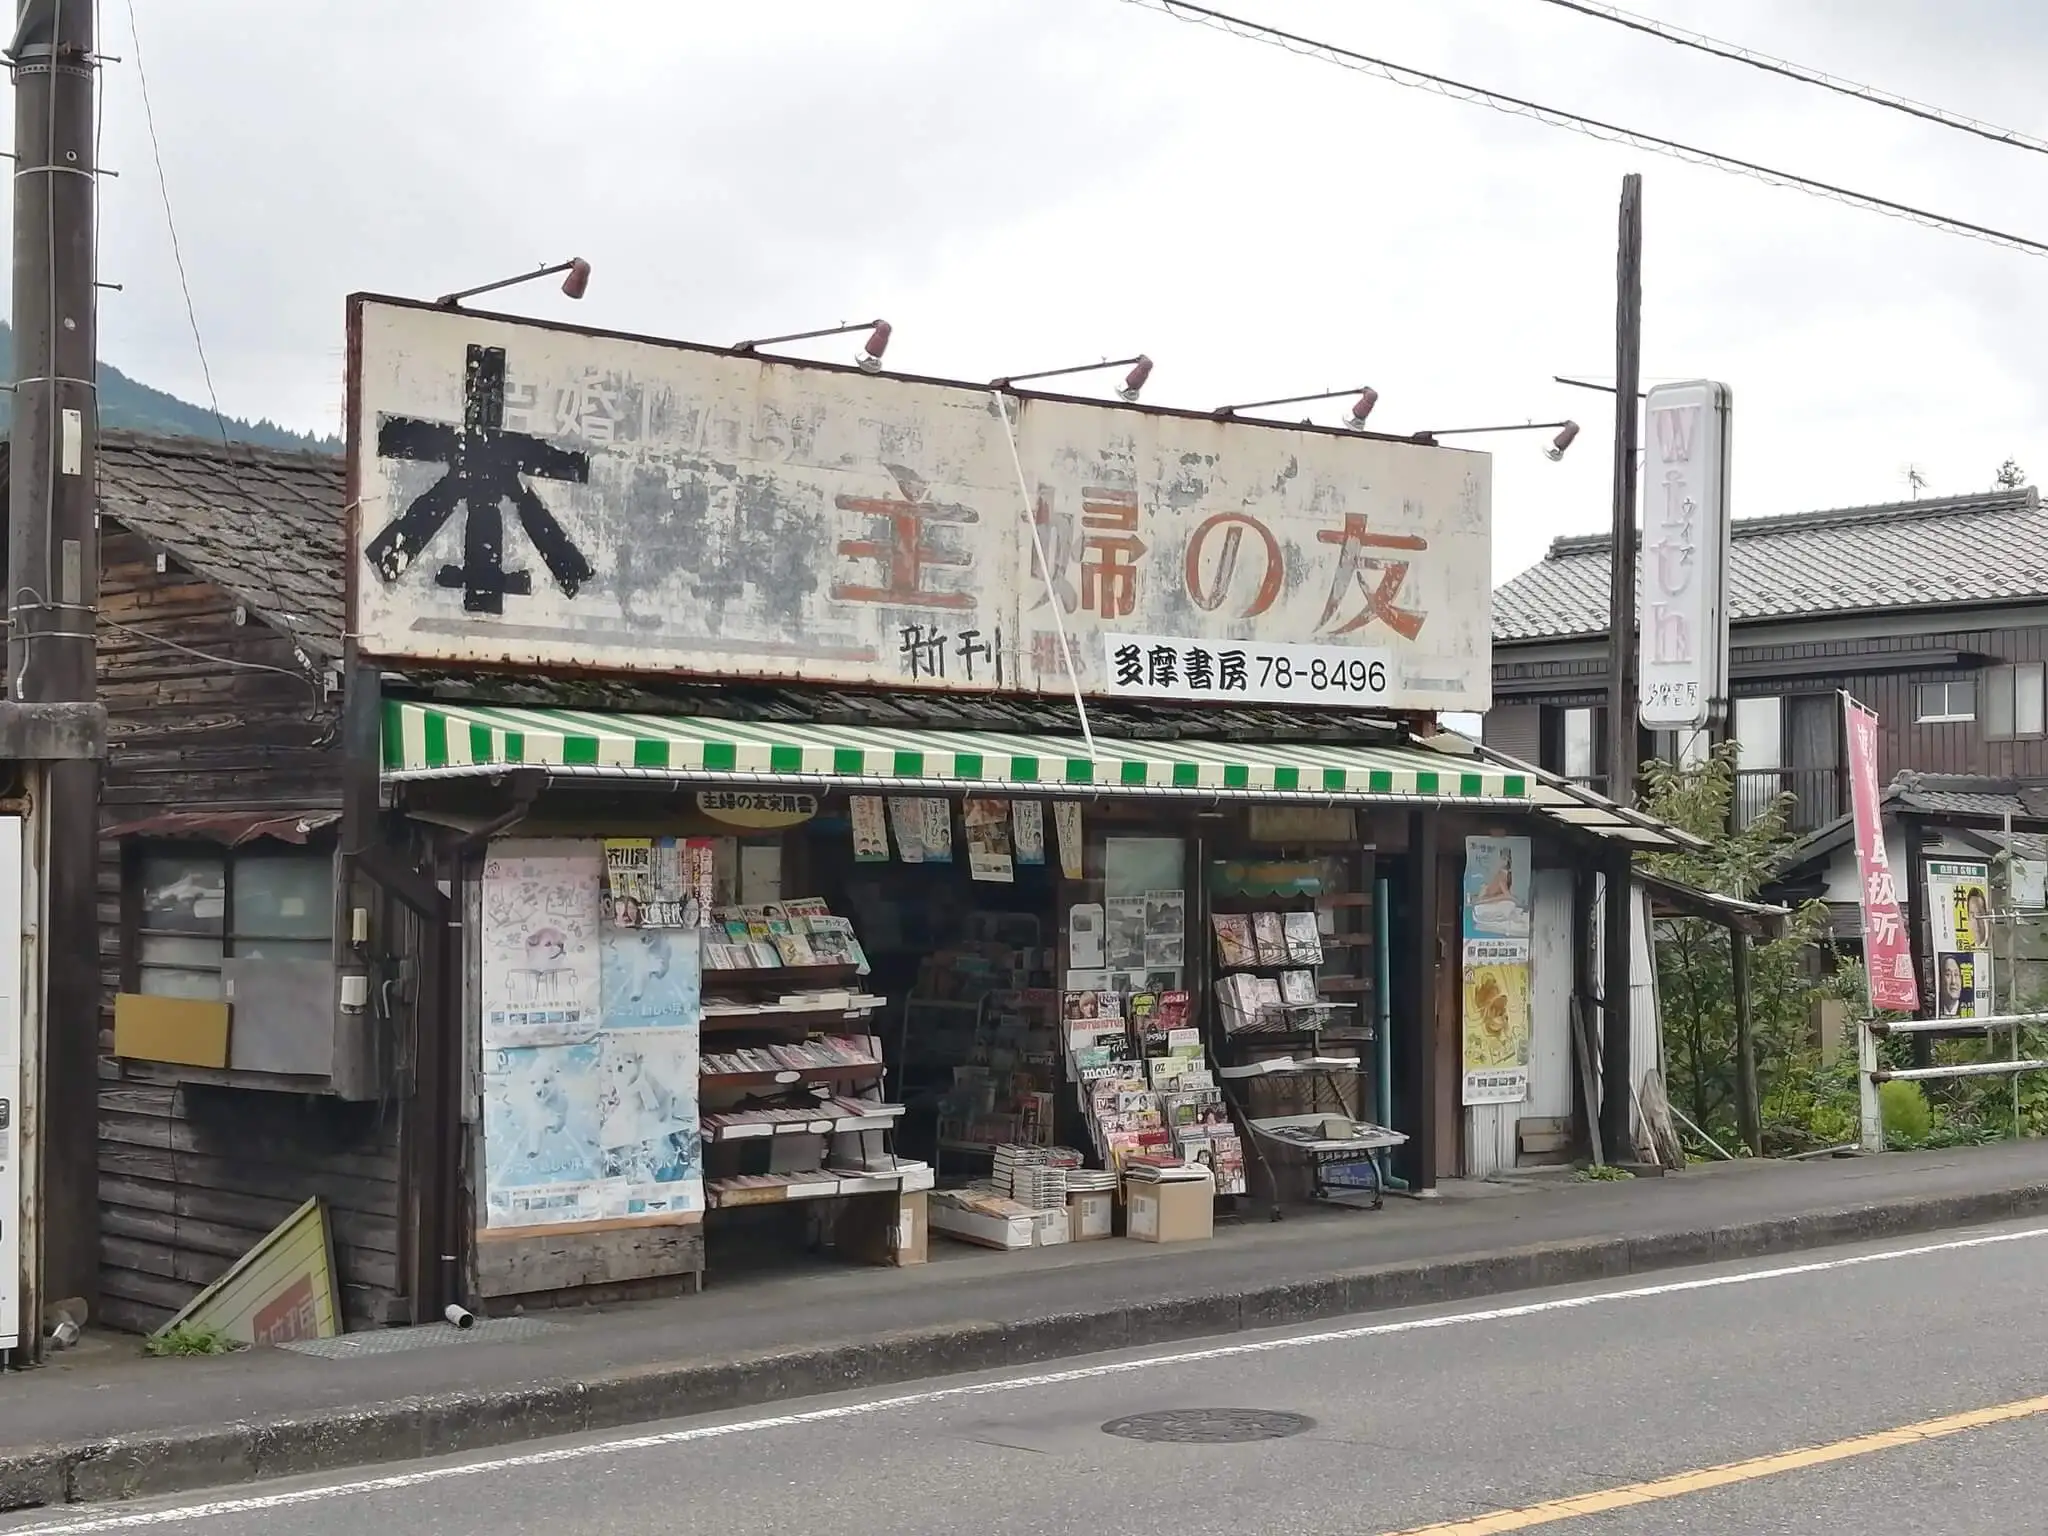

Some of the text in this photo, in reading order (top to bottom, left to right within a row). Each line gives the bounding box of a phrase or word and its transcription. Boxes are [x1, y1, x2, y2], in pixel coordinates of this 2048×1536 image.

[364, 342, 595, 615] 本
[830, 462, 1428, 641] 主婦の友
[1114, 643, 1387, 694] 多摩書房 78-8496
[607, 847, 649, 865] 芥川賞
[1952, 885, 1968, 933] 井上
[1082, 1066, 1118, 1080] mono
